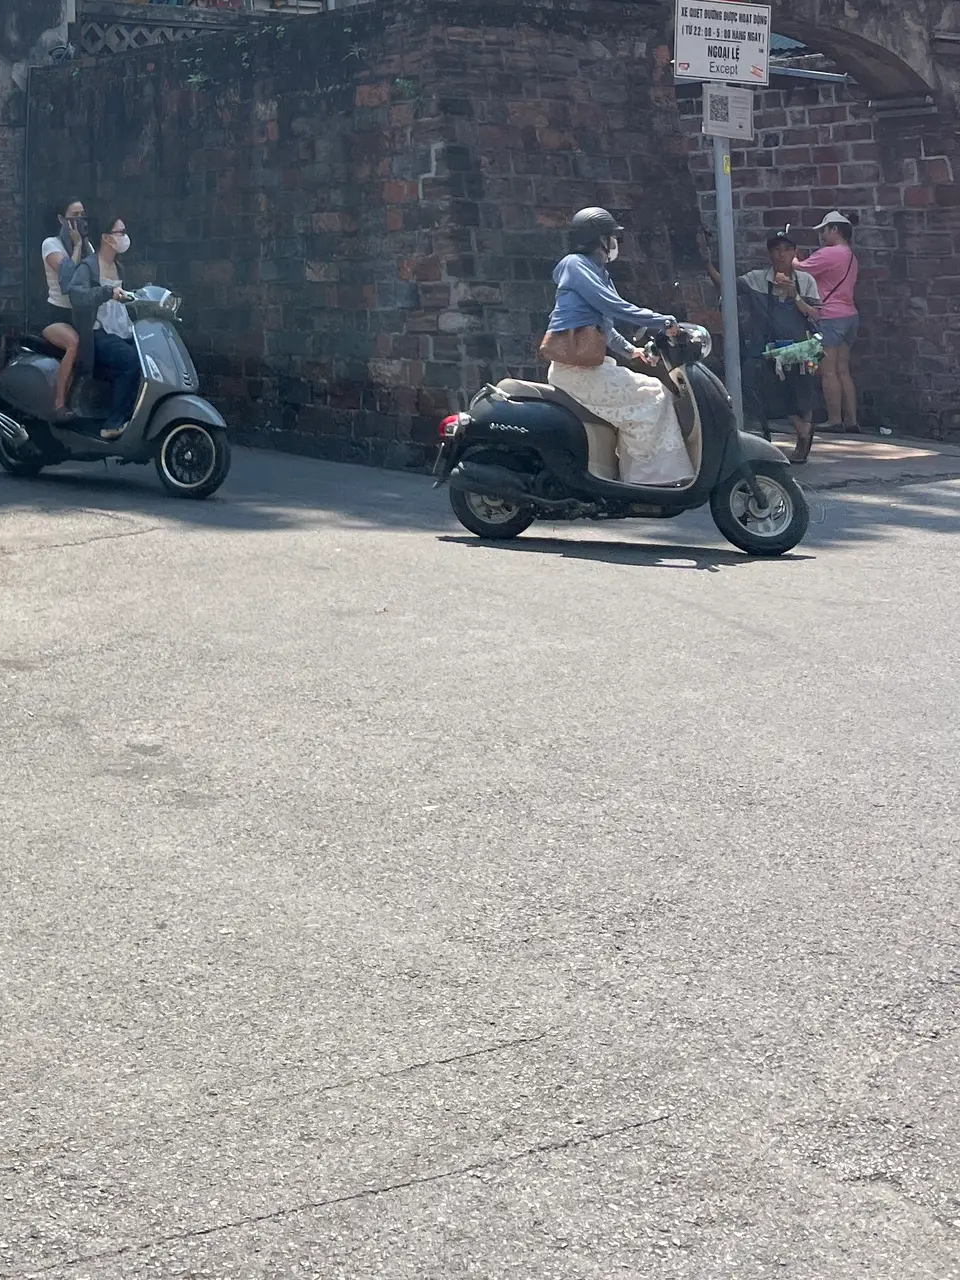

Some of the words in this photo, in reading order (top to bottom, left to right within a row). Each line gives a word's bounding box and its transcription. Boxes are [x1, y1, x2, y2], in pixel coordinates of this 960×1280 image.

[681, 7, 688, 18] XE
[707, 45, 730, 61] NGOẠI
[732, 45, 740, 62] LỆ
[709, 61, 738, 76] Except
